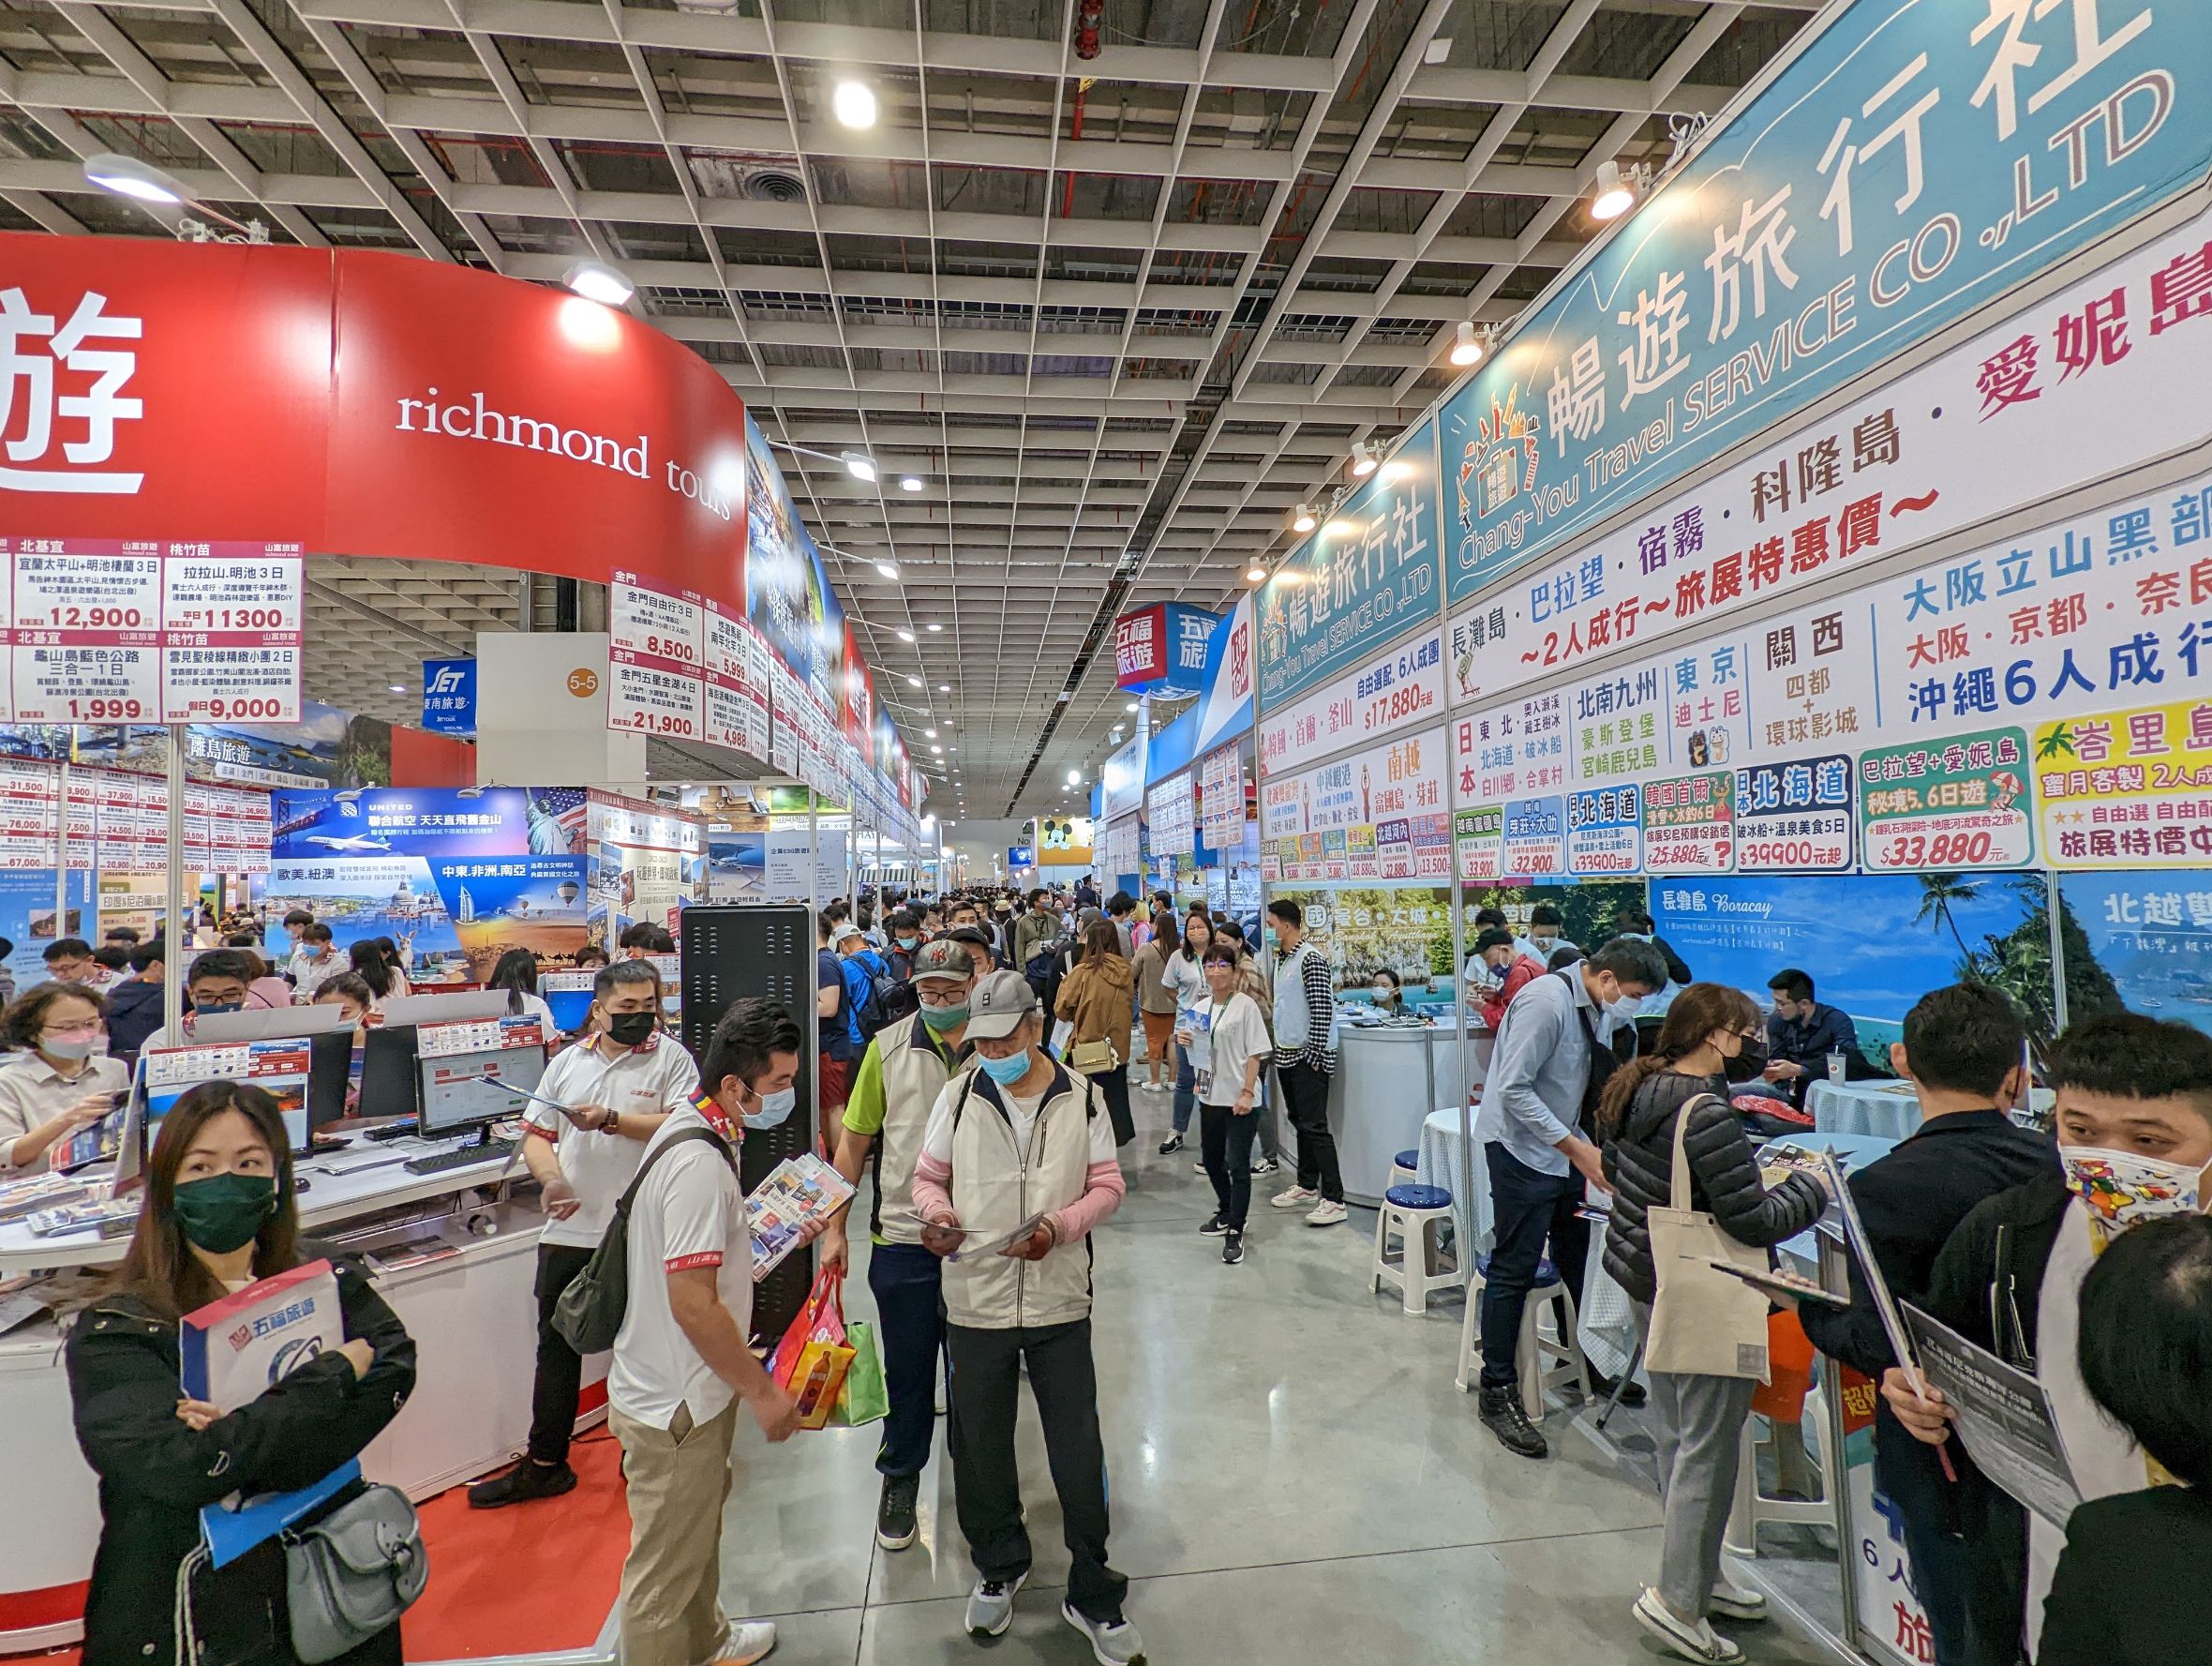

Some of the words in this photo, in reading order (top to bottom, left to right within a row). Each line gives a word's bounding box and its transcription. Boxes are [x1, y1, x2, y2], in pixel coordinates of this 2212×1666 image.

[1547, 0, 2153, 458] 暢遊旅行社
[0, 287, 144, 493] 遊
[1459, 473, 1579, 570] Chang-You
[1584, 398, 1674, 492] Travel
[1682, 276, 1860, 432] SERVICE
[1869, 212, 1962, 309] CO
[396, 387, 650, 479] richmond
[666, 459, 730, 520] tours
[1451, 607, 1506, 660] 長灘島
[1531, 554, 1605, 623] 巴拉望
[1637, 504, 1705, 576] 宿霧
[1750, 408, 1900, 523] 科隆島
[1975, 240, 2212, 426] 愛妮島
[20, 540, 65, 553] 北基宜
[170, 543, 210, 556] 桃竹苗
[1903, 484, 2212, 622] 大阪立山黑部
[615, 570, 636, 585] 金門
[1289, 485, 1427, 644] 暢遊旅行社
[51, 607, 142, 629] 12,900
[627, 592, 693, 619] 金門自由行3日
[18, 632, 61, 645] 北基宜
[167, 633, 208, 646] 桃竹苗
[1116, 616, 1153, 648] 五福
[1766, 611, 1843, 671] 關西
[1906, 623, 1970, 669] 大阪
[2009, 592, 2087, 645] 京都
[34, 650, 140, 663] 龜山島藍色公路
[614, 650, 635, 664] 金門
[647, 636, 694, 661] 8,500
[1116, 642, 1154, 676] 旅遊
[1179, 641, 1207, 670] 旅
[570, 674, 597, 689] 5-5
[706, 670, 719, 684] 金門
[724, 658, 745, 681] 5,999
[1675, 645, 1737, 695] 東京
[1786, 667, 1831, 699] 四都
[1577, 668, 1656, 720] 北南九州
[1676, 689, 1741, 728] 迪士尼
[67, 698, 142, 721] 1,999
[210, 698, 281, 721] 9,000
[634, 711, 693, 736] 21,900
[724, 728, 747, 749] 4,988
[1582, 713, 1655, 750] 豪斯登堡
[1766, 706, 1859, 746] 環球影城
[2073, 704, 2212, 761] 峇里島
[190, 736, 251, 765] 離島旅遊
[1386, 739, 1421, 783] 南越
[1481, 744, 1514, 770] 北海道
[1525, 737, 1562, 758] 破冰船
[1582, 744, 1657, 779] 宮崎鹿兒島
[1863, 738, 2019, 781] 巴拉望+愛妮島
[10, 781, 42, 791] 31,500
[1527, 765, 1562, 789] 合掌村
[1754, 761, 1846, 808] 北海道
[2041, 765, 2145, 798] 蜜月客製
[1581, 790, 1637, 824] 北海道
[1645, 778, 1710, 807] 韓國首爾
[368, 815, 417, 827] 聯合航空
[2092, 803, 2149, 823] 自由選
[1378, 823, 1408, 843] 北越河內
[1662, 890, 1707, 911] 長灘島
[1712, 893, 1772, 919] Boracay
